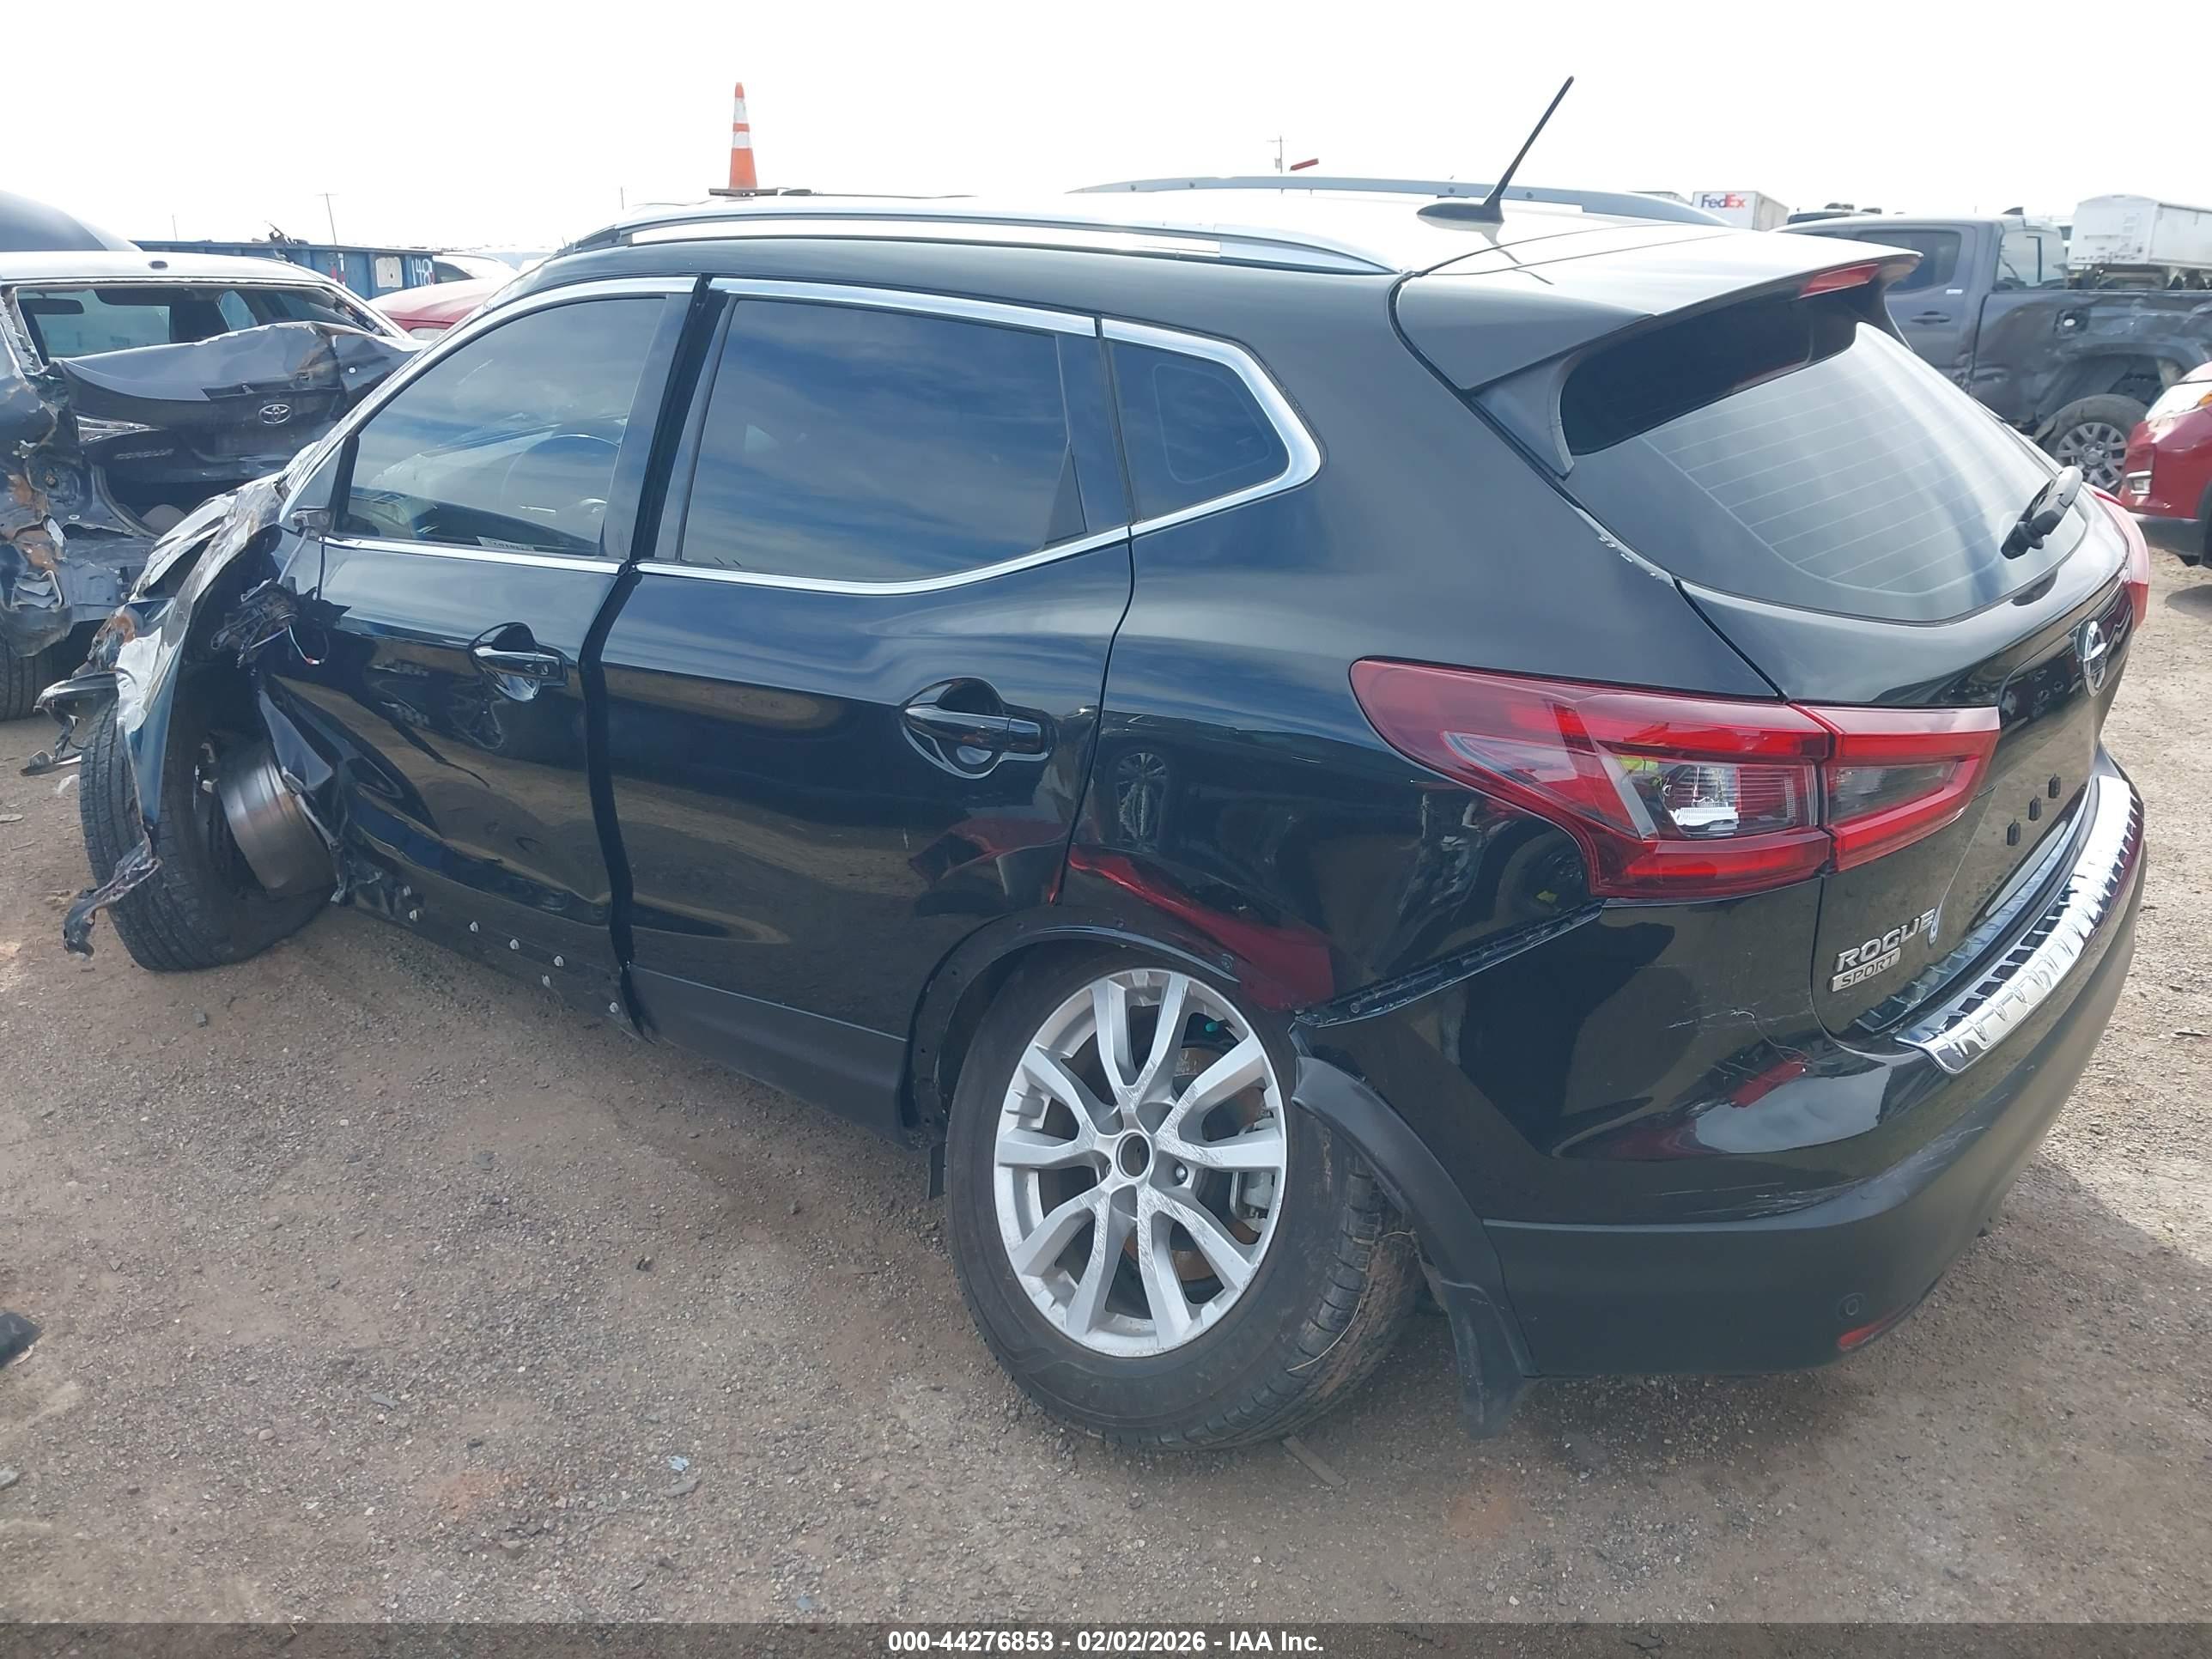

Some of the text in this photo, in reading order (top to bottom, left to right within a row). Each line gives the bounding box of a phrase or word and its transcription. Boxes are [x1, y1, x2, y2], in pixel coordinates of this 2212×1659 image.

[1701, 193, 1747, 208] FedEx
[1836, 908, 1936, 972] ROGUE
[1840, 955, 1896, 988] SPORT
